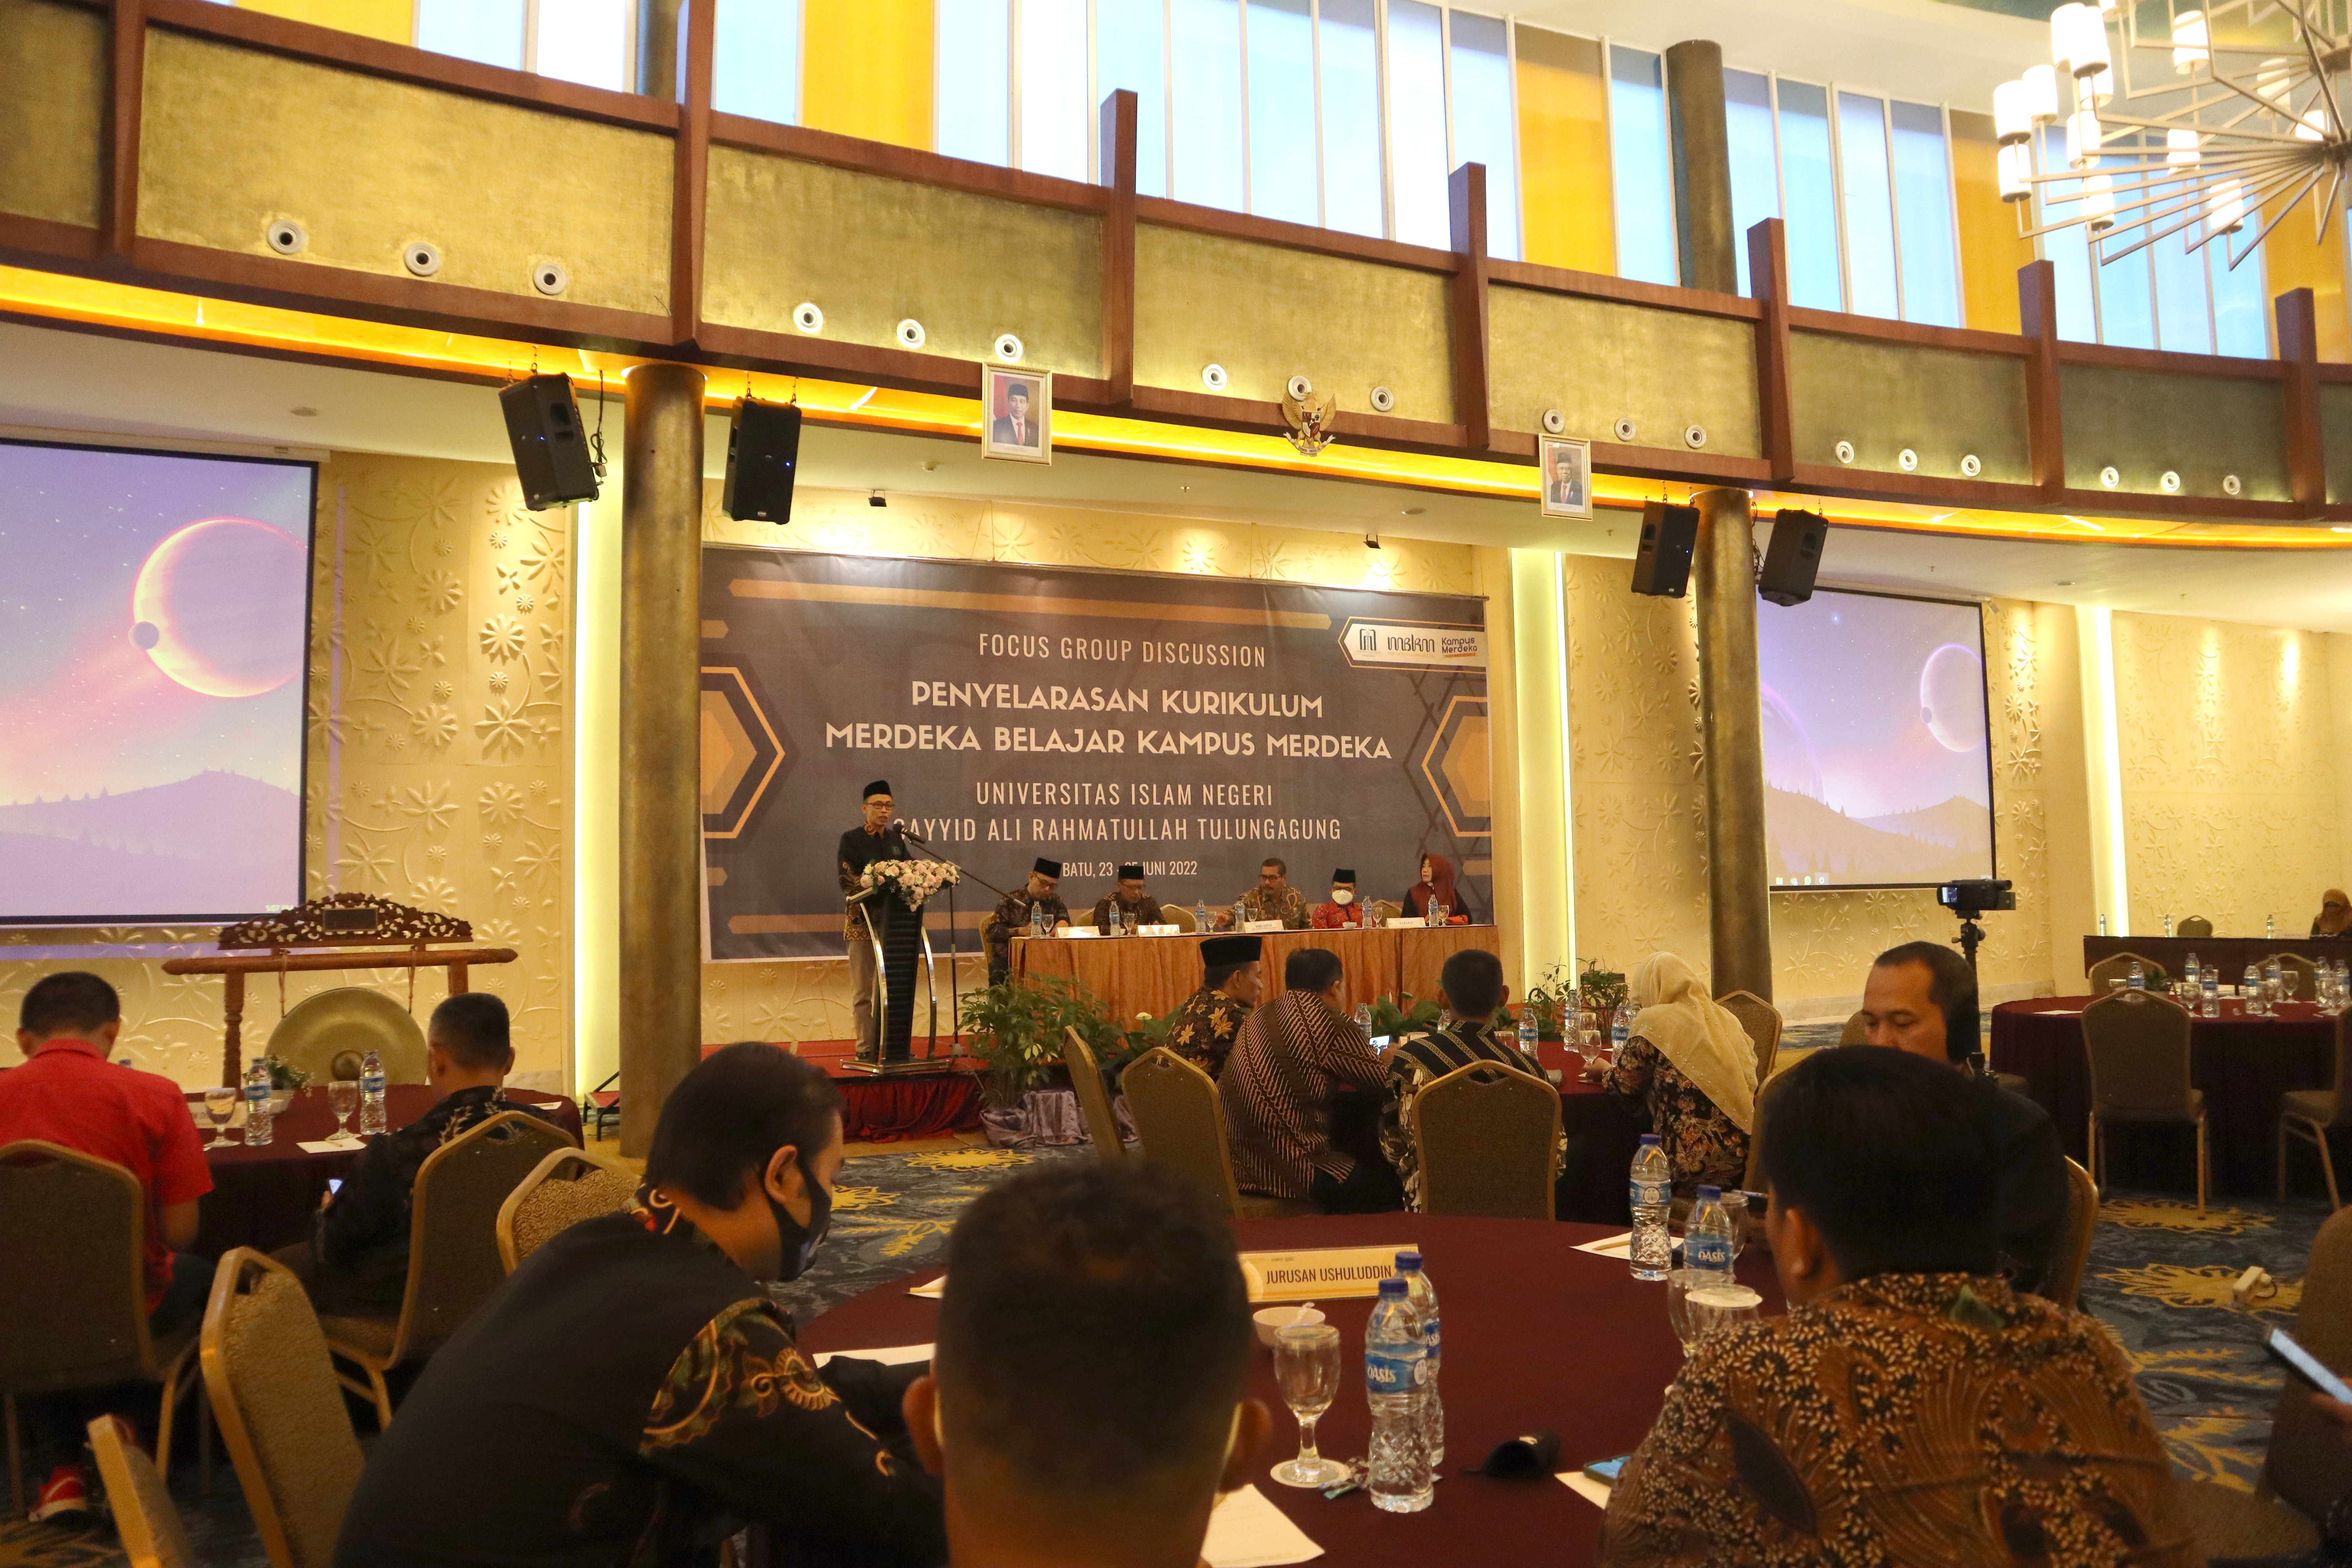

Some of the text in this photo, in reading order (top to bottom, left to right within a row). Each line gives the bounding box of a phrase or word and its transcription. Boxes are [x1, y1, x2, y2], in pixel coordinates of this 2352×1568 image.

[980, 633, 1265, 668] FOCUS GROUP DISCUSSION
[1442, 637, 1475, 646] Kampus
[1442, 644, 1477, 653] Merdeka
[912, 681, 1322, 718] PENYELARASAN KURIKULUM
[826, 722, 1392, 759] MERDEKA BELAJAR KAMPUS MERDEKA
[976, 782, 1272, 806] UNIVERSITAS ISLAM NEGERI
[987, 818, 1020, 841] ALI
[1033, 818, 1187, 841] RAHMATULLAH
[1197, 818, 1341, 840] TULUNGAGUNG
[1063, 862, 1096, 878] BATU,
[1099, 862, 1113, 877] 23
[1169, 861, 1197, 876] 2022
[1266, 1265, 1392, 1285] JURUSAN USHULUDDIN
